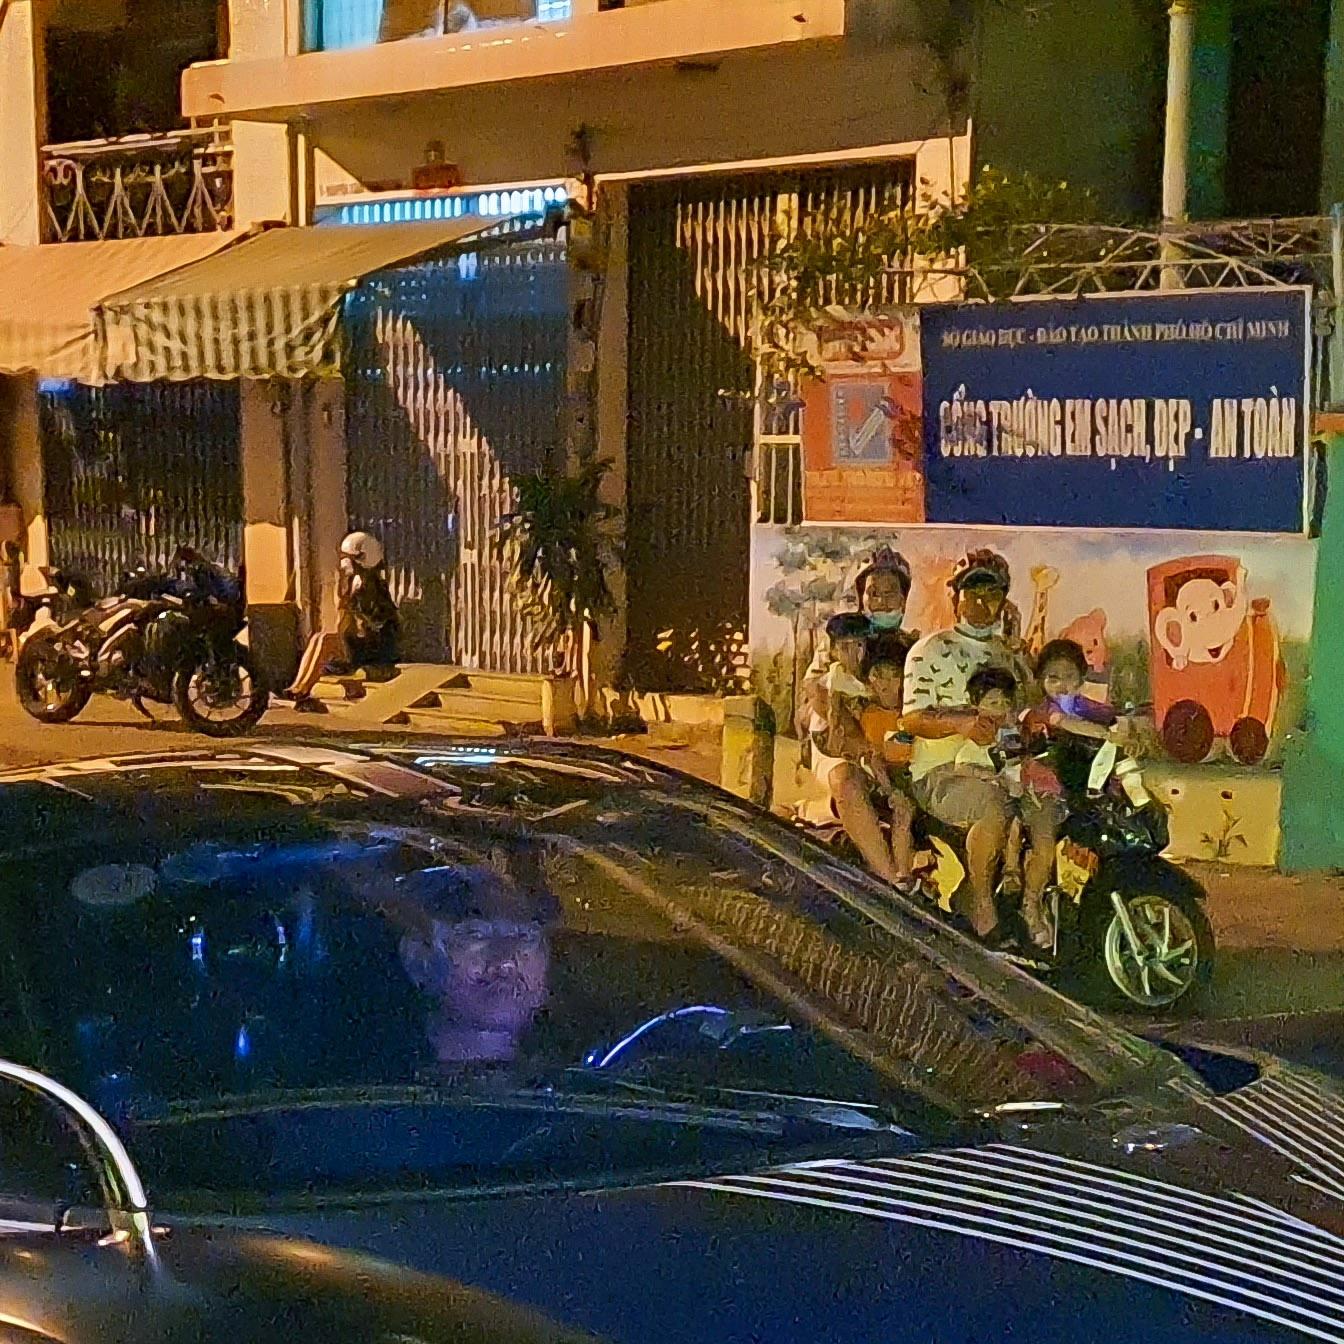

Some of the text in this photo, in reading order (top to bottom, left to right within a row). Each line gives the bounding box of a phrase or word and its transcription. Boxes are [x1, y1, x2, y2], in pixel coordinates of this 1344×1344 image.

[1065, 398, 1092, 456] EM
[1210, 398, 1238, 458] AN
[1241, 385, 1296, 459] TOÀN
